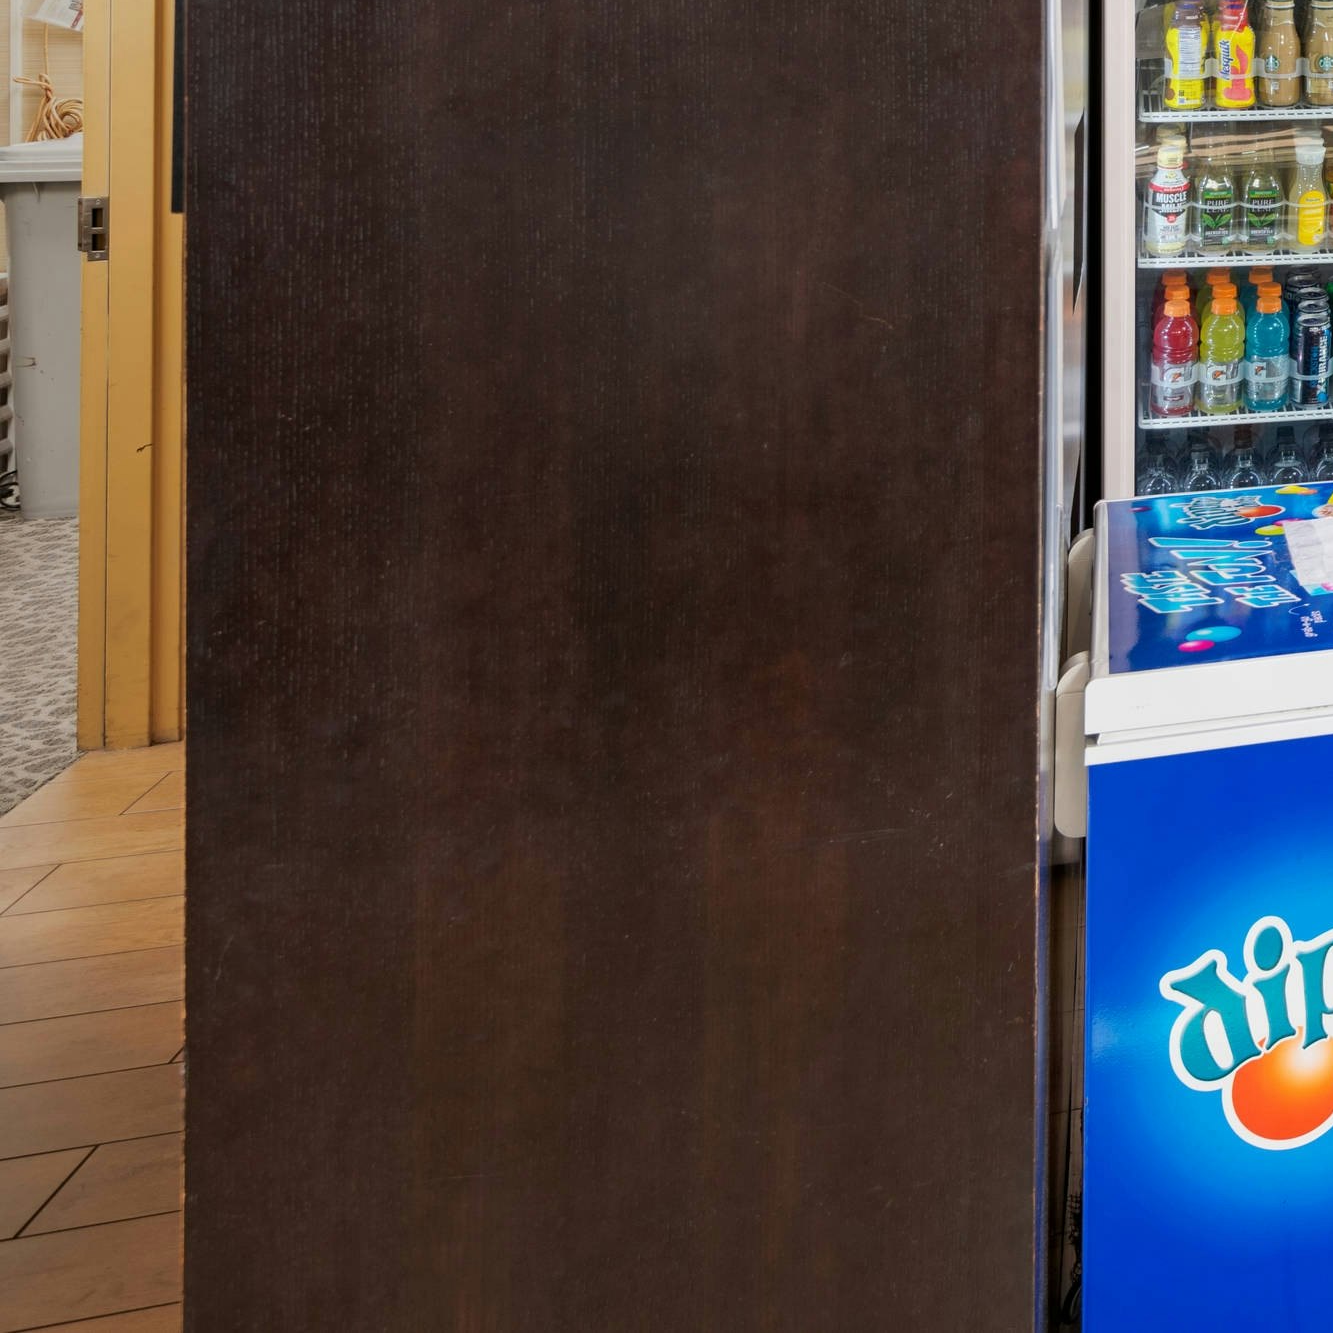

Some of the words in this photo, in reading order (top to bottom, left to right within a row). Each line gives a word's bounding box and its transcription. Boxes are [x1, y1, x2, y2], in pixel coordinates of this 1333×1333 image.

[1156, 192, 1187, 203] MUSCLE
[1148, 537, 1276, 586] FUN!
[1120, 570, 1224, 614] TASTE
[1223, 584, 1301, 608] THE
